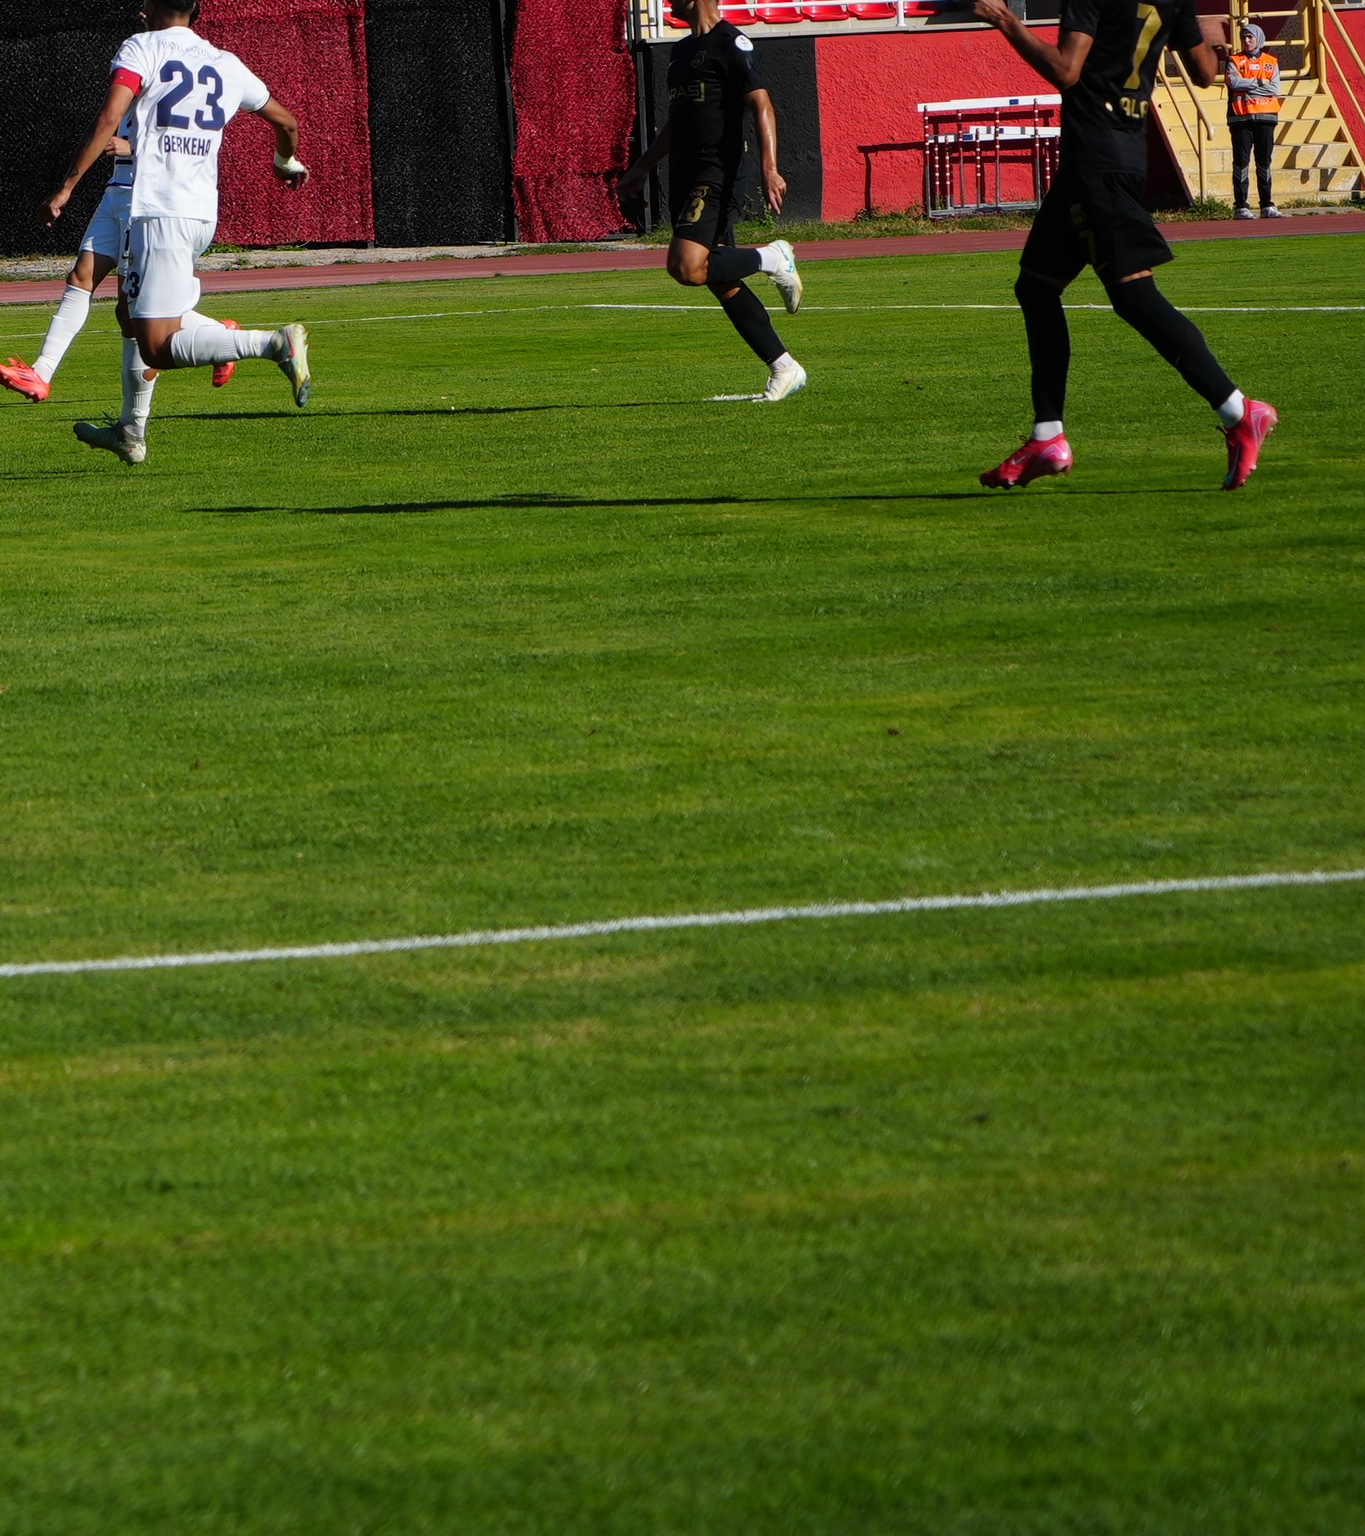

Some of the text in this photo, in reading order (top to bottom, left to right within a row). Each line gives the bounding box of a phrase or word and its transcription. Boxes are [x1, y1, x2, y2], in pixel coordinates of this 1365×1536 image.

[1123, 2, 1163, 90] 7
[156, 59, 226, 132] 23
[127, 271, 140, 299] 3
